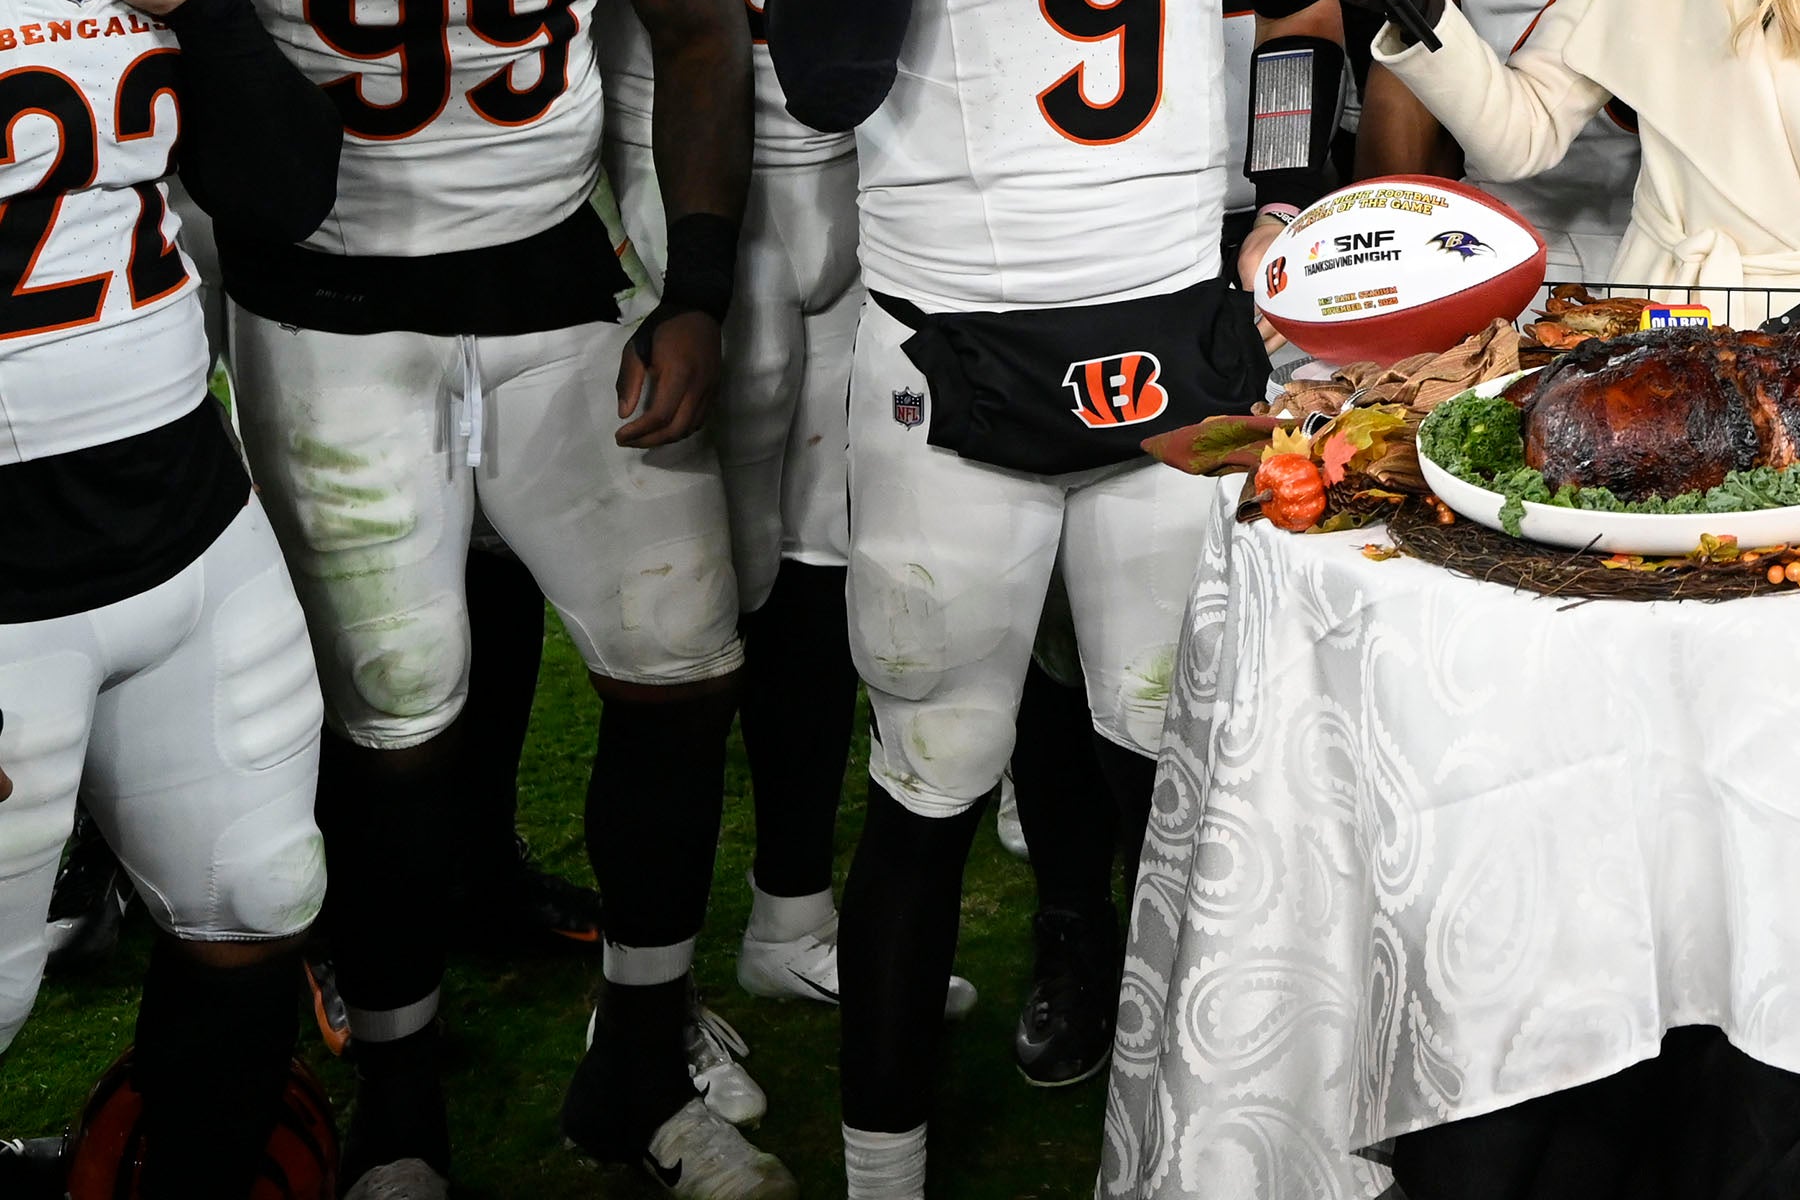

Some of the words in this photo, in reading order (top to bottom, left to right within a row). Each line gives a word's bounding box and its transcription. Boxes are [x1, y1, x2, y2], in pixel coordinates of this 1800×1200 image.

[0, 47, 190, 340] 22
[1376, 188, 1449, 208] FOOTBALL
[1336, 200, 1356, 213] OF
[1358, 198, 1387, 209] THE
[1391, 199, 1434, 216] GAME
[1334, 229, 1396, 254] SNF
[1303, 255, 1353, 278] THANKSGIVING
[1353, 249, 1402, 266] NIGHT
[1358, 286, 1398, 300] STADIUM
[1651, 316, 1678, 330] OLD
[1680, 316, 1705, 328] BAY
